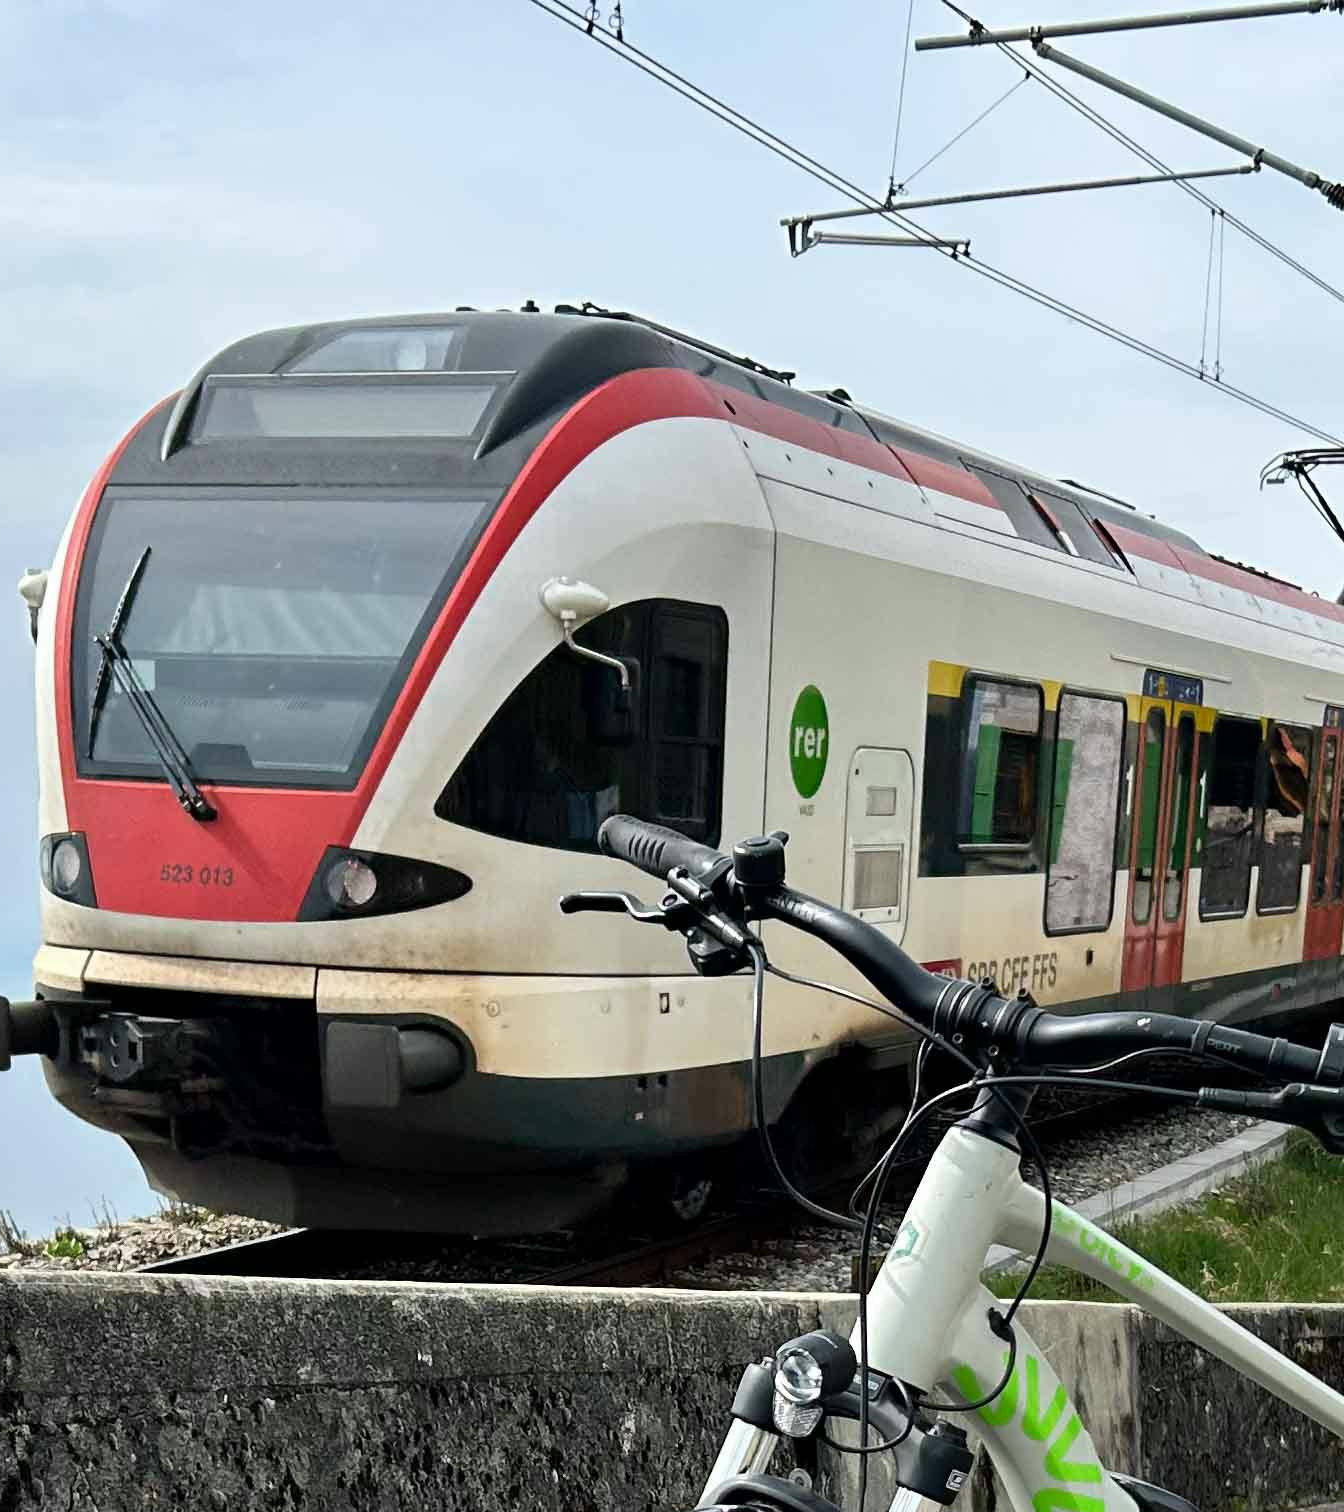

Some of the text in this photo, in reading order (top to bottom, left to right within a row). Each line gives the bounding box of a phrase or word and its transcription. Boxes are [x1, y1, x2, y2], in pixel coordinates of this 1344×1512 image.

[794, 727, 826, 759] rer
[160, 864, 234, 887] 523 013
[1001, 956, 1029, 993] CFF
[1032, 952, 1058, 991] FFS
